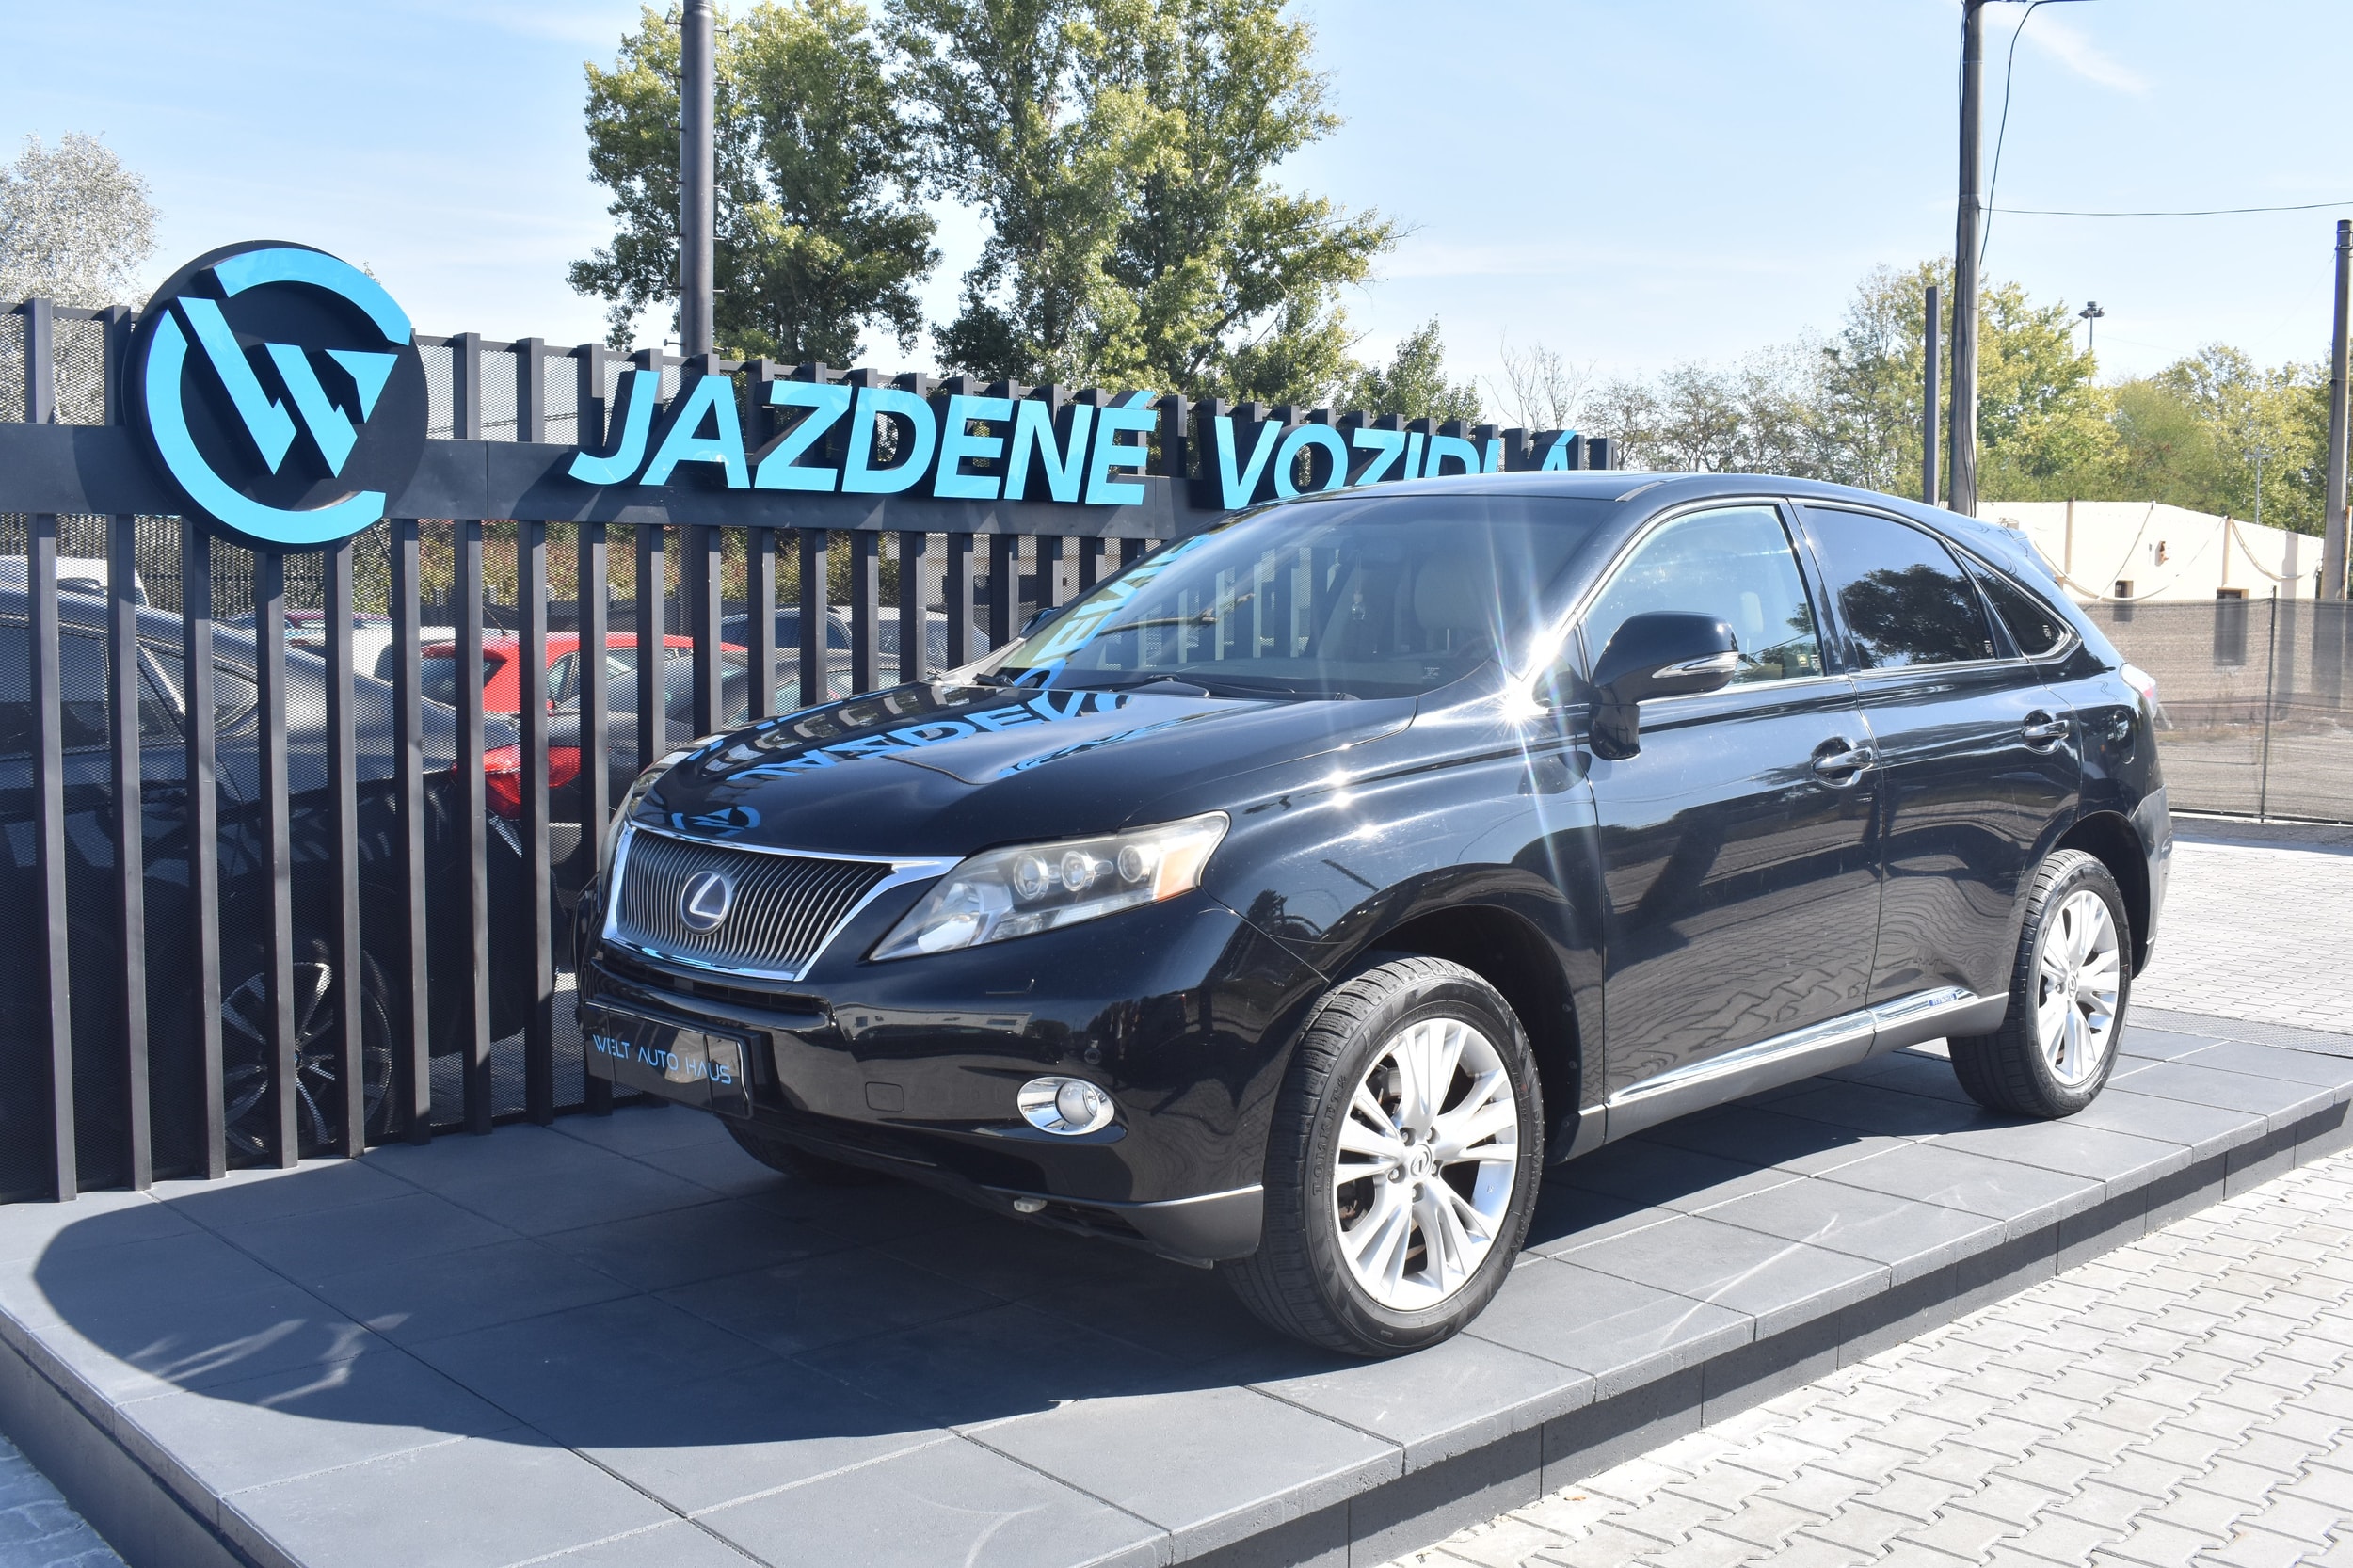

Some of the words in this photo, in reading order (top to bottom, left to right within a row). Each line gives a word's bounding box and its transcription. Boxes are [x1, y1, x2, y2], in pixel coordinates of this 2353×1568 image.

[568, 370, 1158, 505] JAZDENÉ
[593, 1033, 631, 1060] WELT
[637, 1046, 679, 1071] AUTO
[685, 1056, 732, 1084] HAUS
